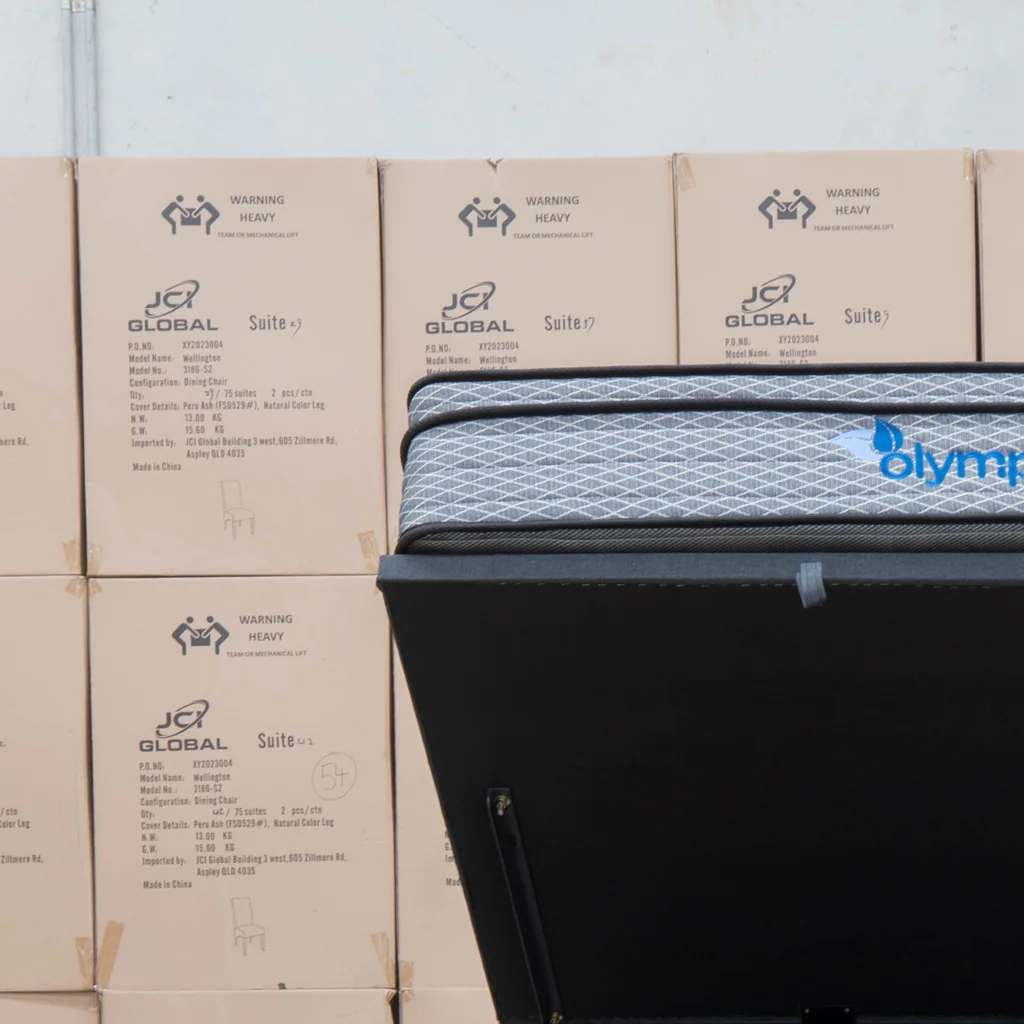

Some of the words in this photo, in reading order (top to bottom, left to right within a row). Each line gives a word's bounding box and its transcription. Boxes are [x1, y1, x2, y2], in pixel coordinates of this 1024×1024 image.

[826, 188, 879, 198] WARNING
[230, 196, 284, 205] WARNING
[526, 196, 579, 206] WARNING
[836, 205, 870, 215] HEAVY
[240, 213, 275, 222] HEAVY
[536, 213, 570, 223] HEAVY
[742, 285, 789, 304] JCI
[145, 291, 192, 309] JCI
[442, 292, 489, 311] JCI
[725, 313, 814, 327] GLOBAL
[845, 308, 881, 324] Suite
[128, 319, 218, 331] GLOBAL
[249, 315, 286, 330] Suite
[425, 320, 514, 334] GLOBAL
[545, 315, 580, 330] Suite
[779, 335, 819, 344] XY2023004
[182, 341, 223, 349] XY2023004
[479, 341, 519, 351] XY2023004
[129, 355, 150, 363] Model
[183, 354, 220, 363] Wellington
[726, 350, 746, 359] Model
[779, 348, 816, 358] Wellington
[426, 357, 447, 365] Model
[479, 354, 516, 365] Wellington
[129, 366, 150, 374] Model
[184, 378, 206, 386] Dining
[208, 377, 227, 386] Chair
[234, 389, 256, 398] suites
[131, 403, 150, 411] Cover
[183, 402, 199, 411] Peru
[201, 402, 213, 410] Ash
[264, 401, 290, 410] Natural
[292, 401, 310, 409] Color
[312, 401, 325, 410] Leg
[213, 414, 222, 422] KG
[215, 426, 224, 434] KG
[132, 439, 164, 448] Imported
[198, 437, 220, 446] Global
[222, 437, 251, 447] Building
[294, 436, 323, 445] Zillmere
[187, 450, 209, 459] Aspley
[211, 450, 225, 458] QLD
[227, 449, 245, 457] 4035
[133, 463, 152, 471] Made
[154, 463, 160, 471] in
[162, 462, 181, 470] China
[239, 614, 293, 625] WARNING
[249, 632, 284, 642] HEAVY
[156, 711, 202, 729] JCI
[139, 738, 227, 752] GLOBAL
[259, 733, 295, 748] Suite
[193, 759, 233, 768] XY2023004
[193, 772, 230, 782] Wellington
[195, 796, 216, 805] Dining
[218, 795, 237, 804] Chair
[273, 818, 299, 828] Natural
[301, 818, 319, 827] Color
[322, 818, 334, 828] Leg
[143, 857, 174, 867] Imported
[144, 881, 163, 889] Made
[165, 881, 171, 889] in
[173, 880, 192, 888] China
